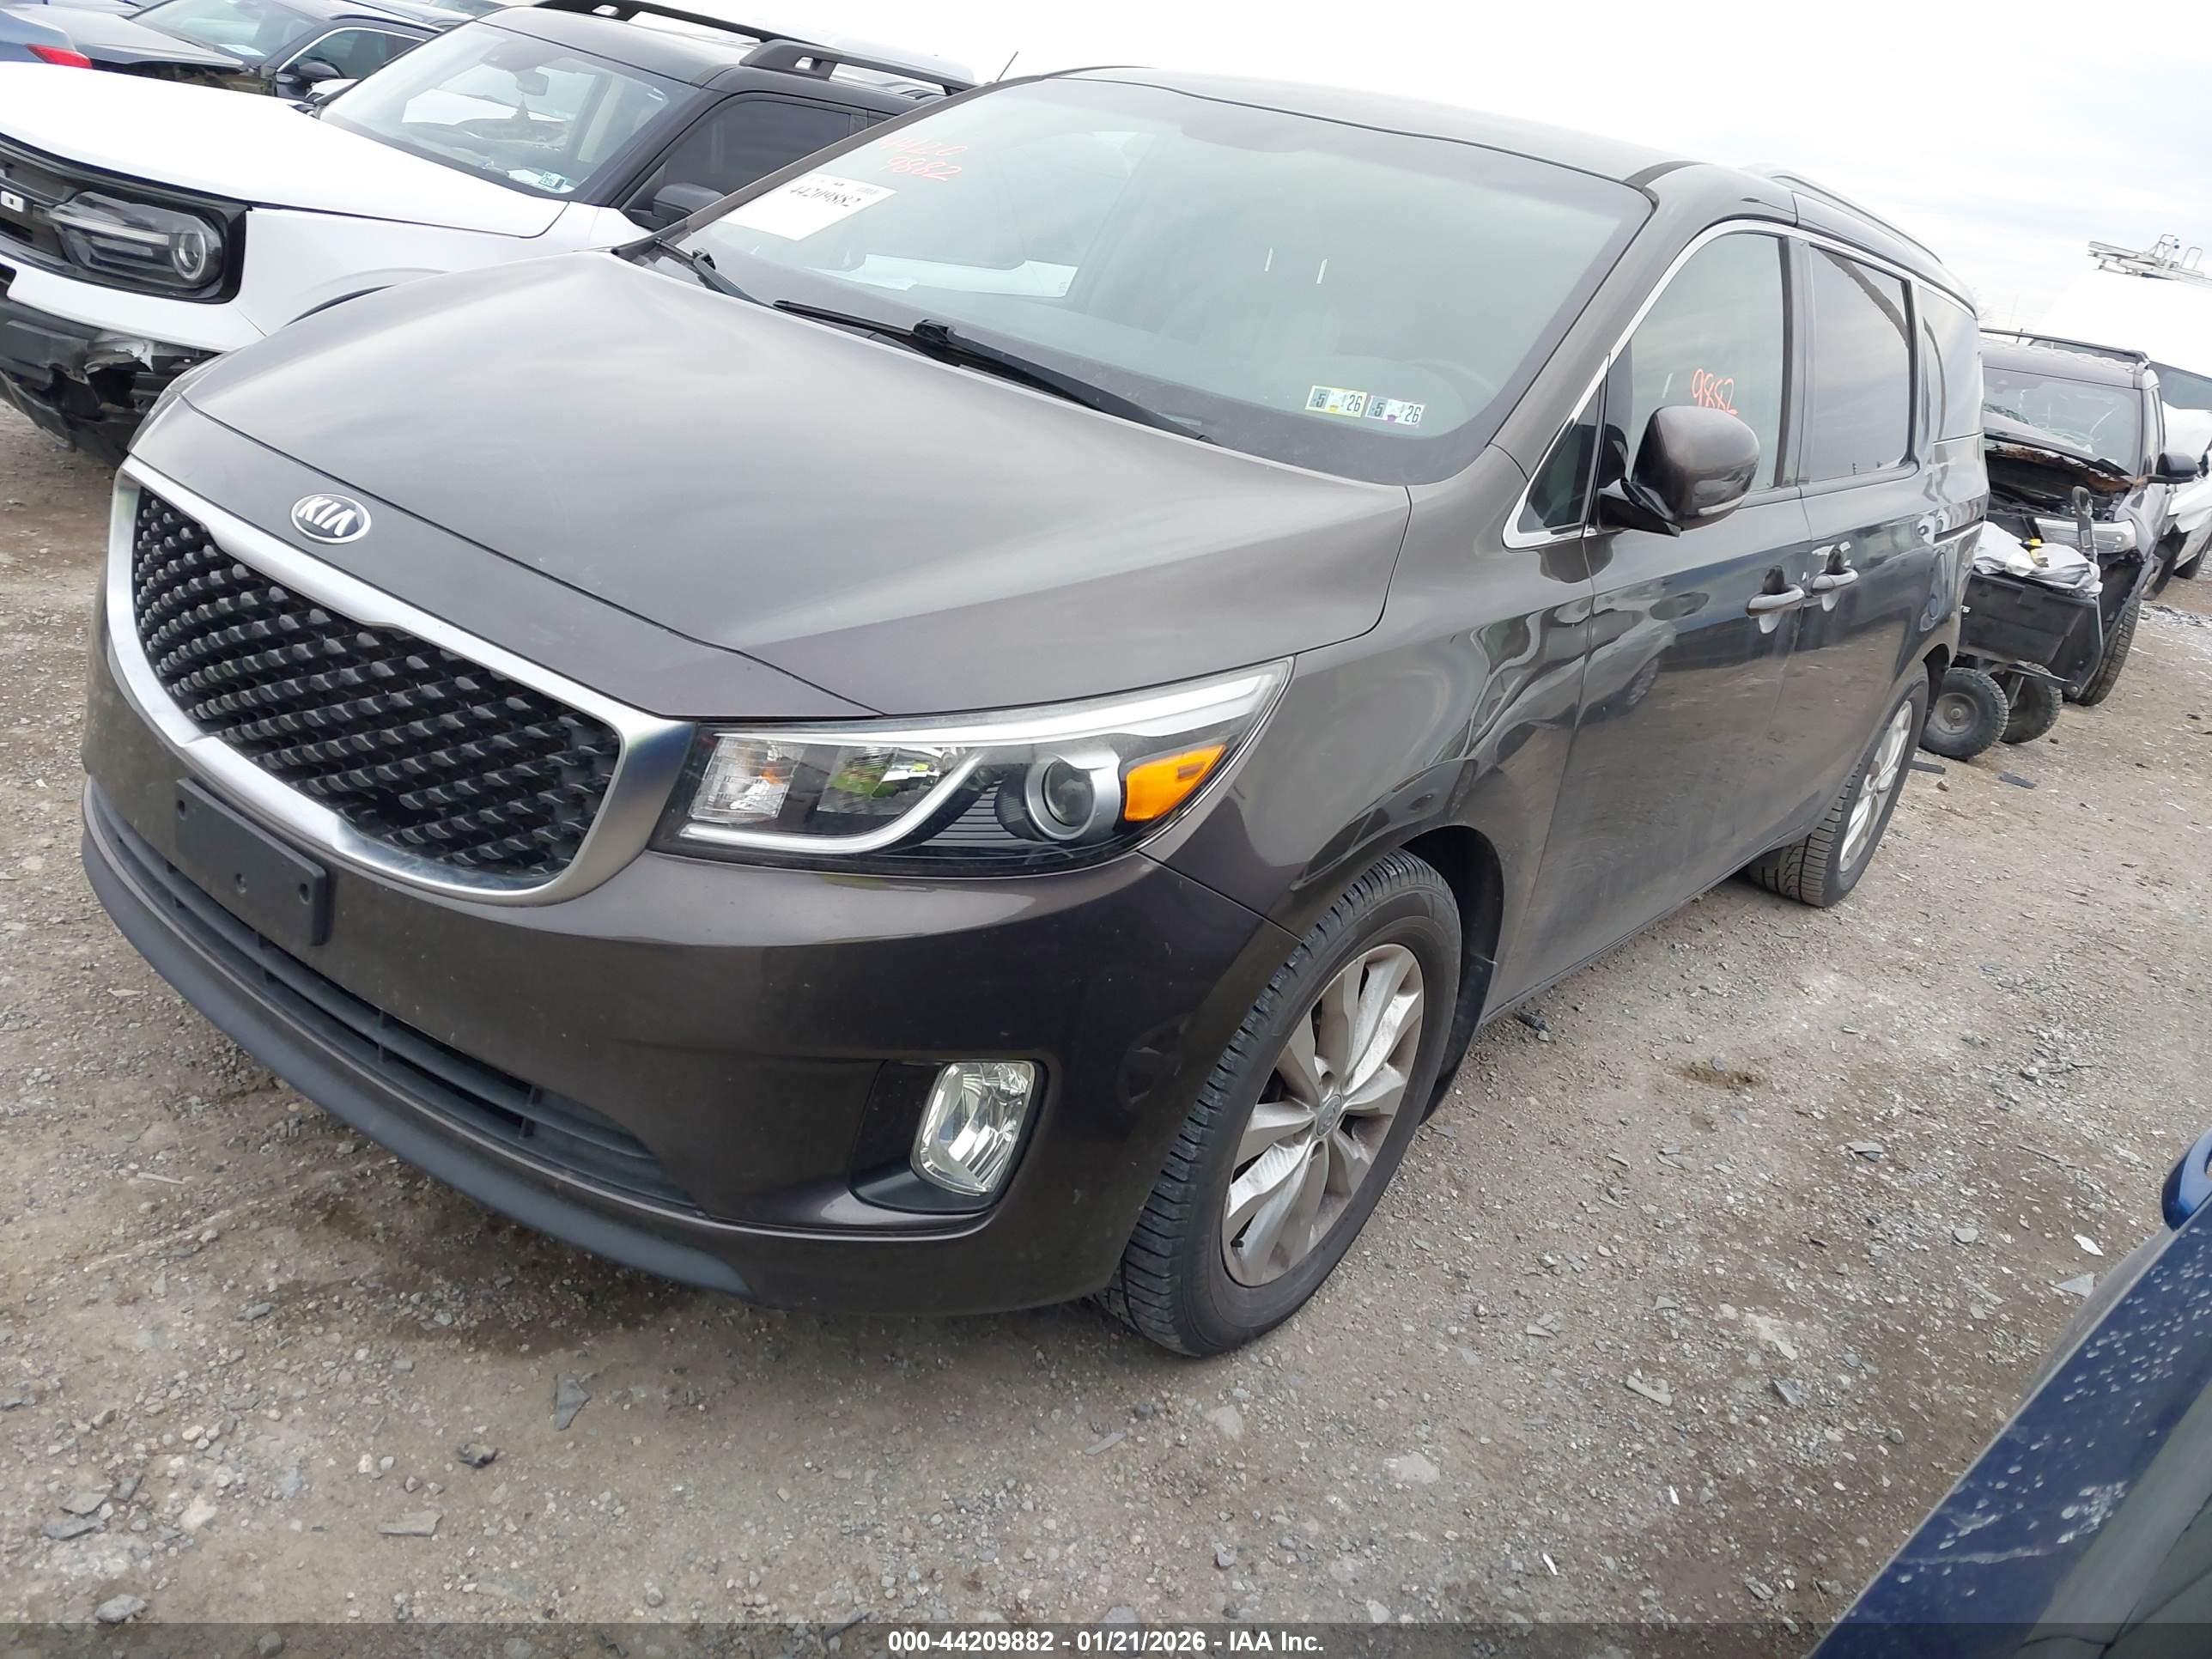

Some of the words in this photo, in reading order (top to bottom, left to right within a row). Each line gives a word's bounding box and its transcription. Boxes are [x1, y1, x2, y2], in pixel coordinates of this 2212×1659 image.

[880, 156, 963, 182] 9882
[1692, 368, 1739, 416] 9882
[296, 496, 357, 537] KIA
